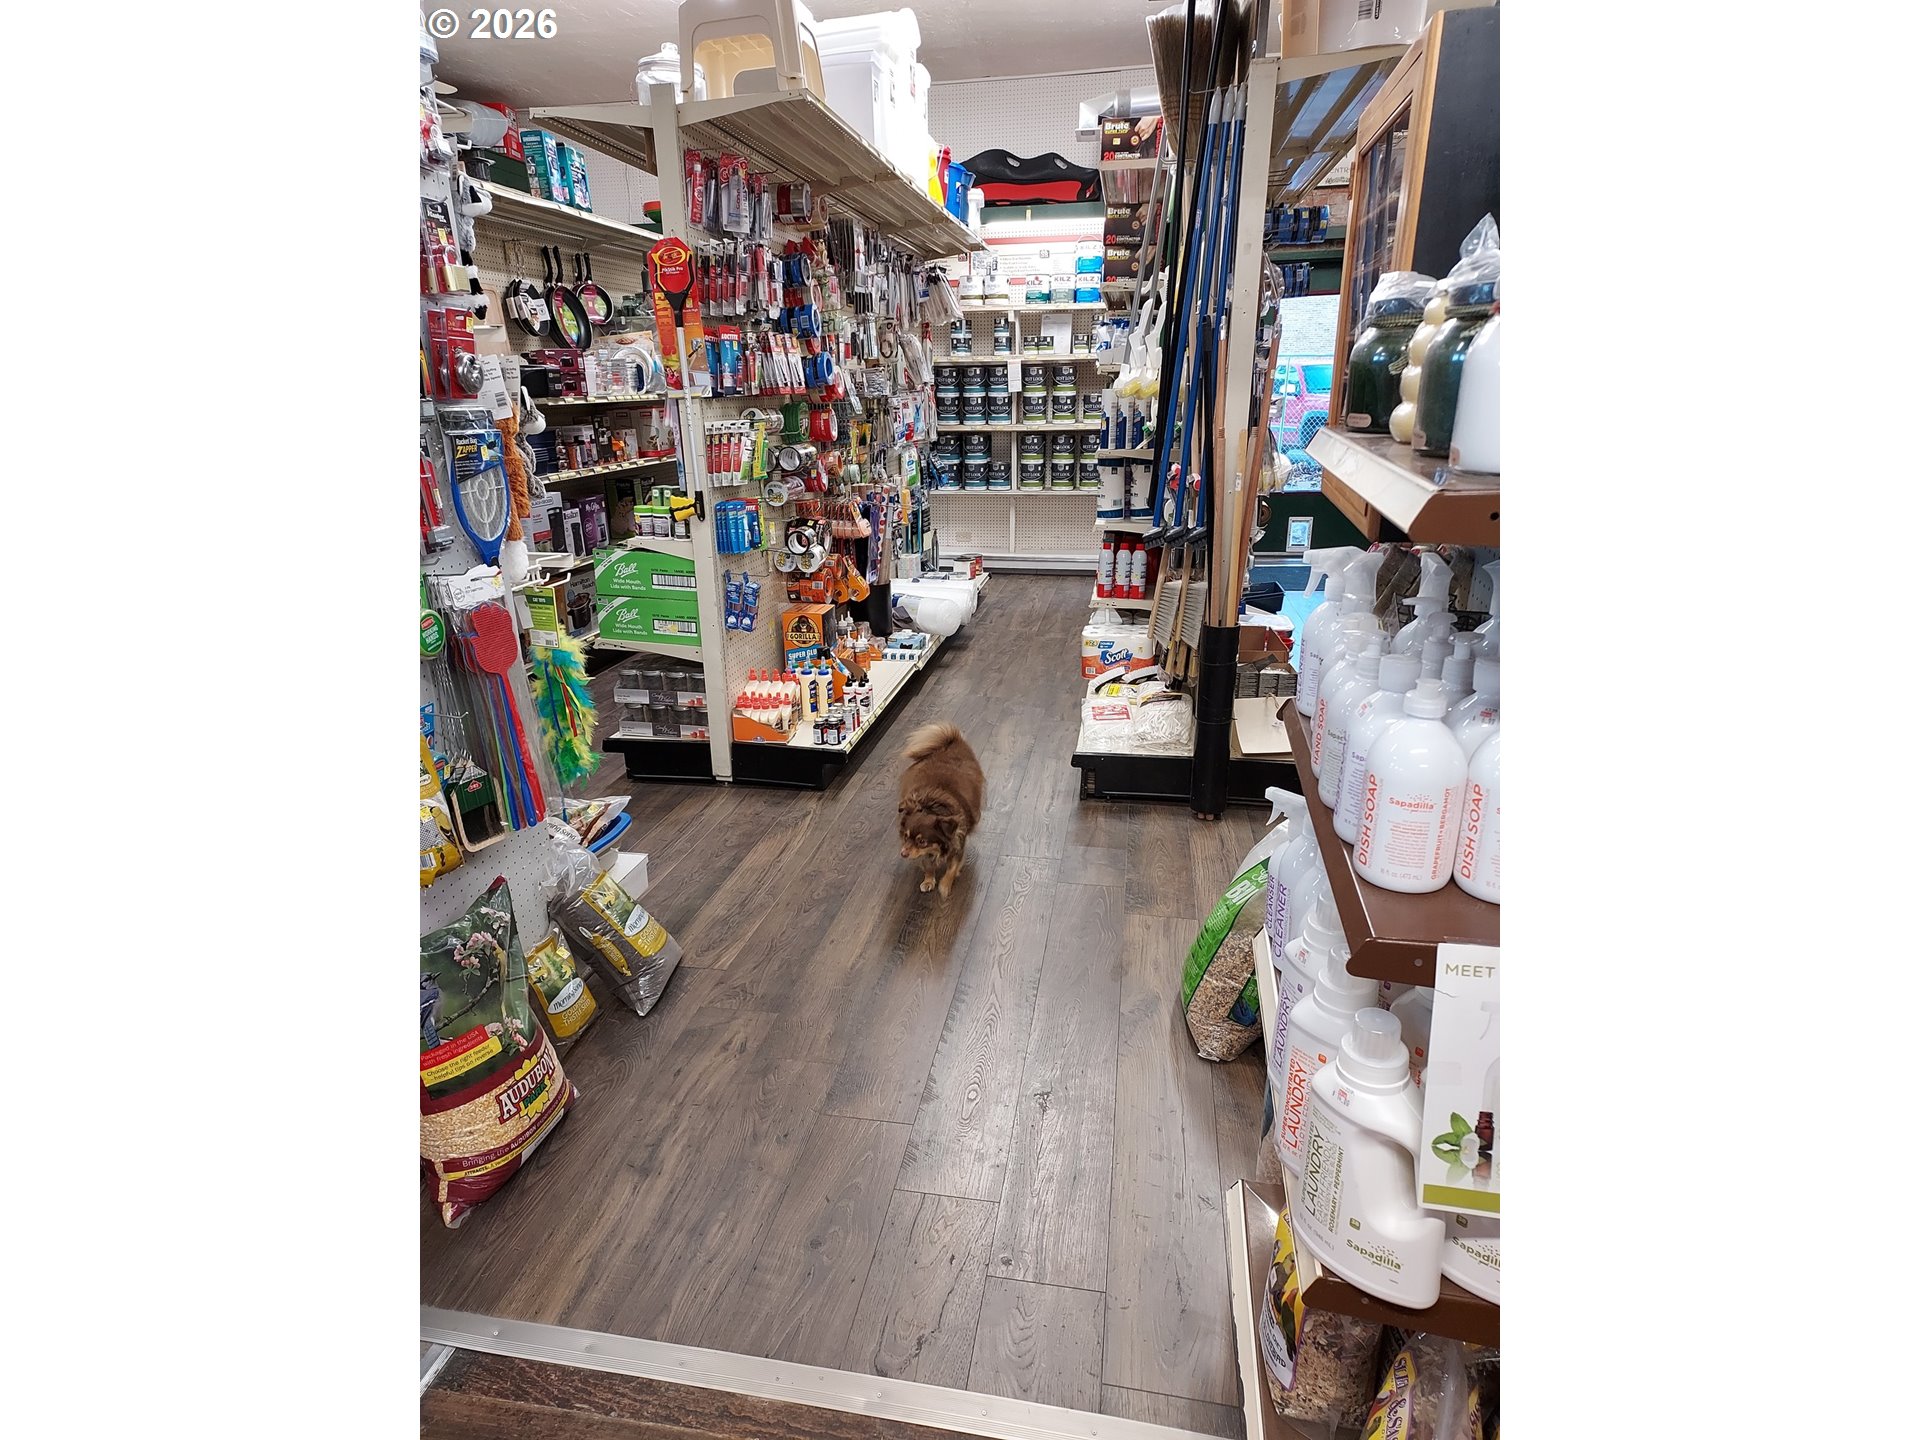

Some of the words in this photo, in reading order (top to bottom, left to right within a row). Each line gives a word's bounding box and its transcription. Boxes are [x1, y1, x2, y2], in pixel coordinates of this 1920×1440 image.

[456, 445, 478, 458] ZAPPER
[614, 562, 639, 577] Ball
[616, 608, 640, 623] Ball
[788, 651, 806, 660] SUPER
[807, 648, 818, 656] GLU
[1104, 648, 1129, 665] Scott
[1313, 733, 1322, 766] HAND
[1318, 699, 1327, 730] SOAP
[1364, 773, 1378, 823] SOAP
[1388, 797, 1435, 811] Sapadilla
[1467, 783, 1484, 834] SOAP
[1359, 824, 1372, 866] DISH
[1460, 836, 1476, 880] DISH
[1266, 874, 1275, 930] CLEANSER
[1274, 883, 1288, 958] CLEANER
[1445, 963, 1496, 979] MEET
[420, 1046, 450, 1061] Packaged
[457, 1037, 467, 1046] the
[466, 1030, 480, 1040] USA
[1274, 989, 1291, 1069] LAUNDRY
[422, 1057, 436, 1068] with
[436, 1051, 453, 1062] fresh
[453, 1035, 484, 1056] ingredients
[427, 1065, 449, 1077] Choose
[449, 1059, 460, 1068] the
[460, 1052, 473, 1064] right
[473, 1044, 490, 1057] feeder
[454, 1064, 466, 1074] tips
[466, 1059, 475, 1067] on
[474, 1049, 494, 1063] reverse
[499, 1047, 554, 1120] AUDUBON
[523, 1082, 547, 1109] PARK
[1284, 1058, 1296, 1116] CONCENTRATED
[1285, 1061, 1308, 1149] LAUNDRY
[462, 1152, 497, 1168] Bringing
[497, 1146, 510, 1157] the
[510, 1125, 538, 1149] AUDUBON
[1320, 1136, 1332, 1187] FRIENDLY
[1305, 1125, 1325, 1217] LAUNDRY
[1328, 1197, 1338, 1233] ROSEMARY
[1333, 1147, 1345, 1190] PEPPERMINT
[1315, 1188, 1326, 1224] EARTH
[1346, 1239, 1401, 1270] Sapadilla
